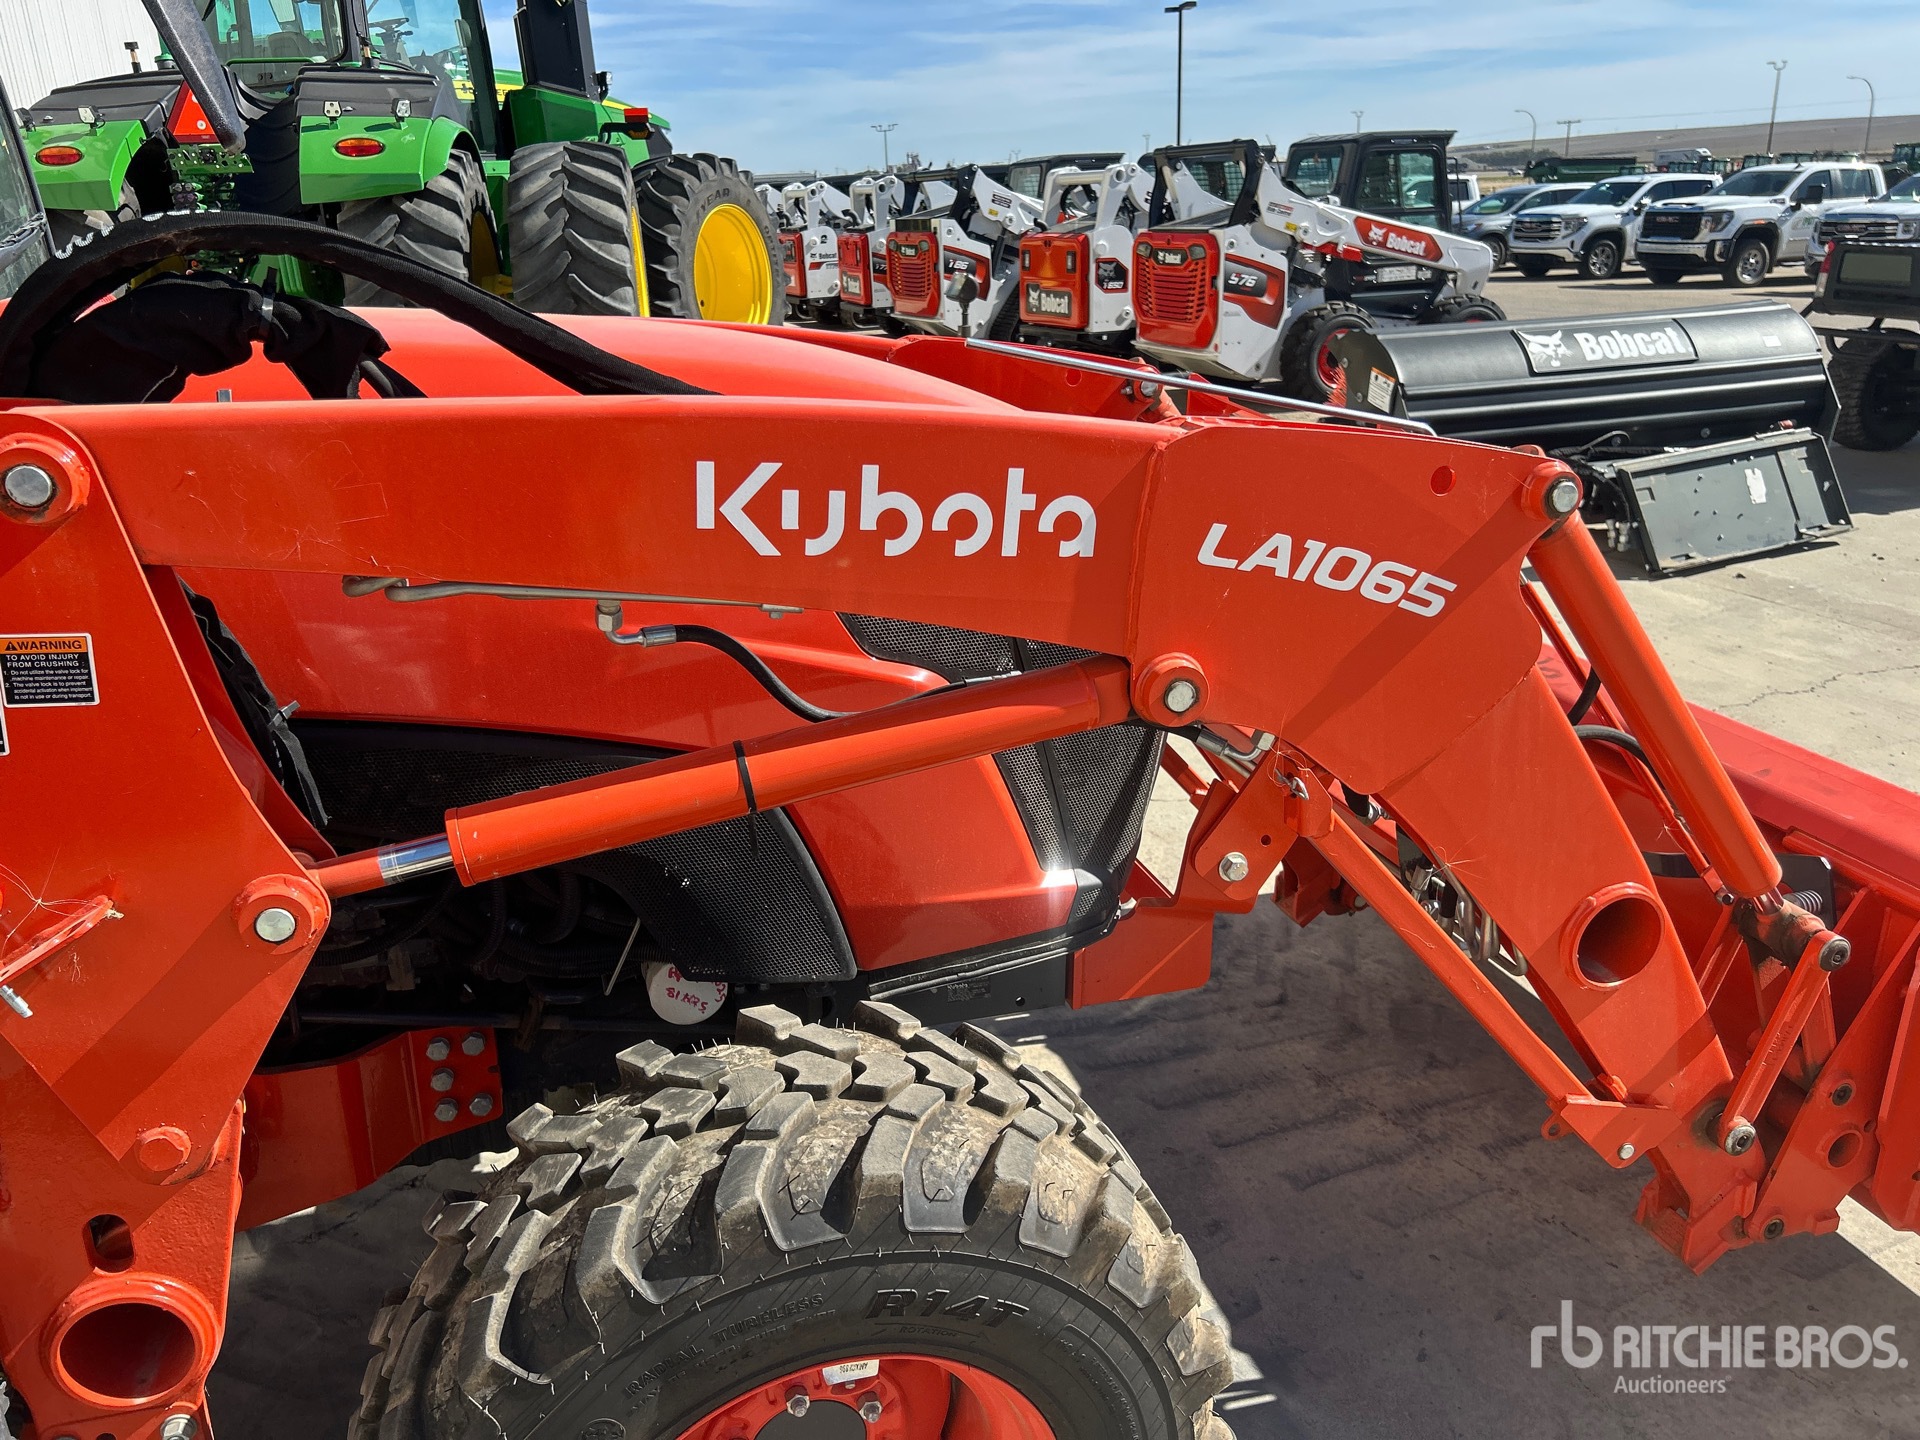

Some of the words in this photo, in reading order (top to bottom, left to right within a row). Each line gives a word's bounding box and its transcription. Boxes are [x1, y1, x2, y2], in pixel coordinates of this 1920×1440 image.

[1165, 252, 1181, 264] Bobcat
[1386, 232, 1426, 256] Bobcat
[1228, 273, 1258, 287] S76
[1041, 293, 1069, 314] Bobcat
[1573, 327, 1686, 361] Bobcat
[696, 460, 1098, 558] Kubota
[1197, 523, 1458, 618] LA1065
[17, 640, 82, 651] WARNING
[865, 1288, 1030, 1328] R14T
[624, 1344, 705, 1400] RADIAL
[713, 1293, 825, 1343] TUBELESS
